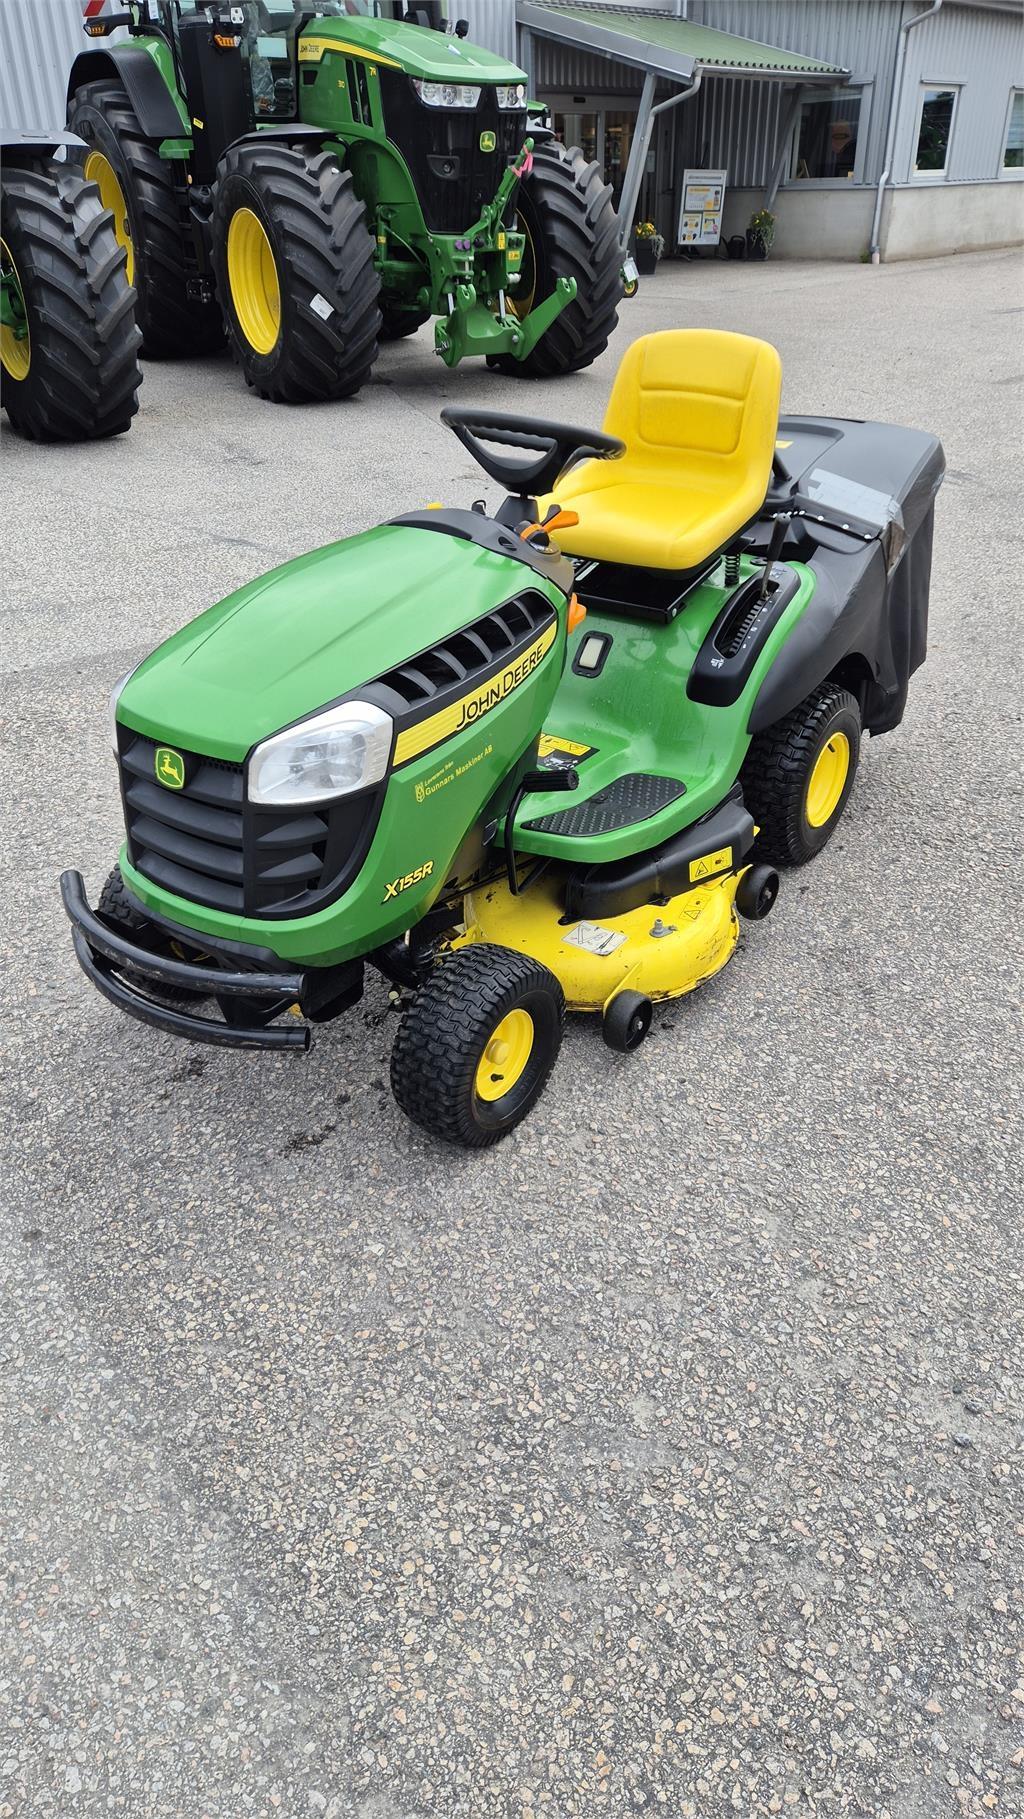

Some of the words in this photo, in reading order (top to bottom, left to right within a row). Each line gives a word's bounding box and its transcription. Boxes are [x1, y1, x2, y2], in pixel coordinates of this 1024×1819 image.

[456, 683, 500, 728] JOHN
[503, 643, 543, 694] DEERE
[425, 774, 455, 796] Gunnars
[455, 753, 483, 777] Maskiner
[484, 744, 493, 757] AB
[382, 860, 434, 903] X155R
